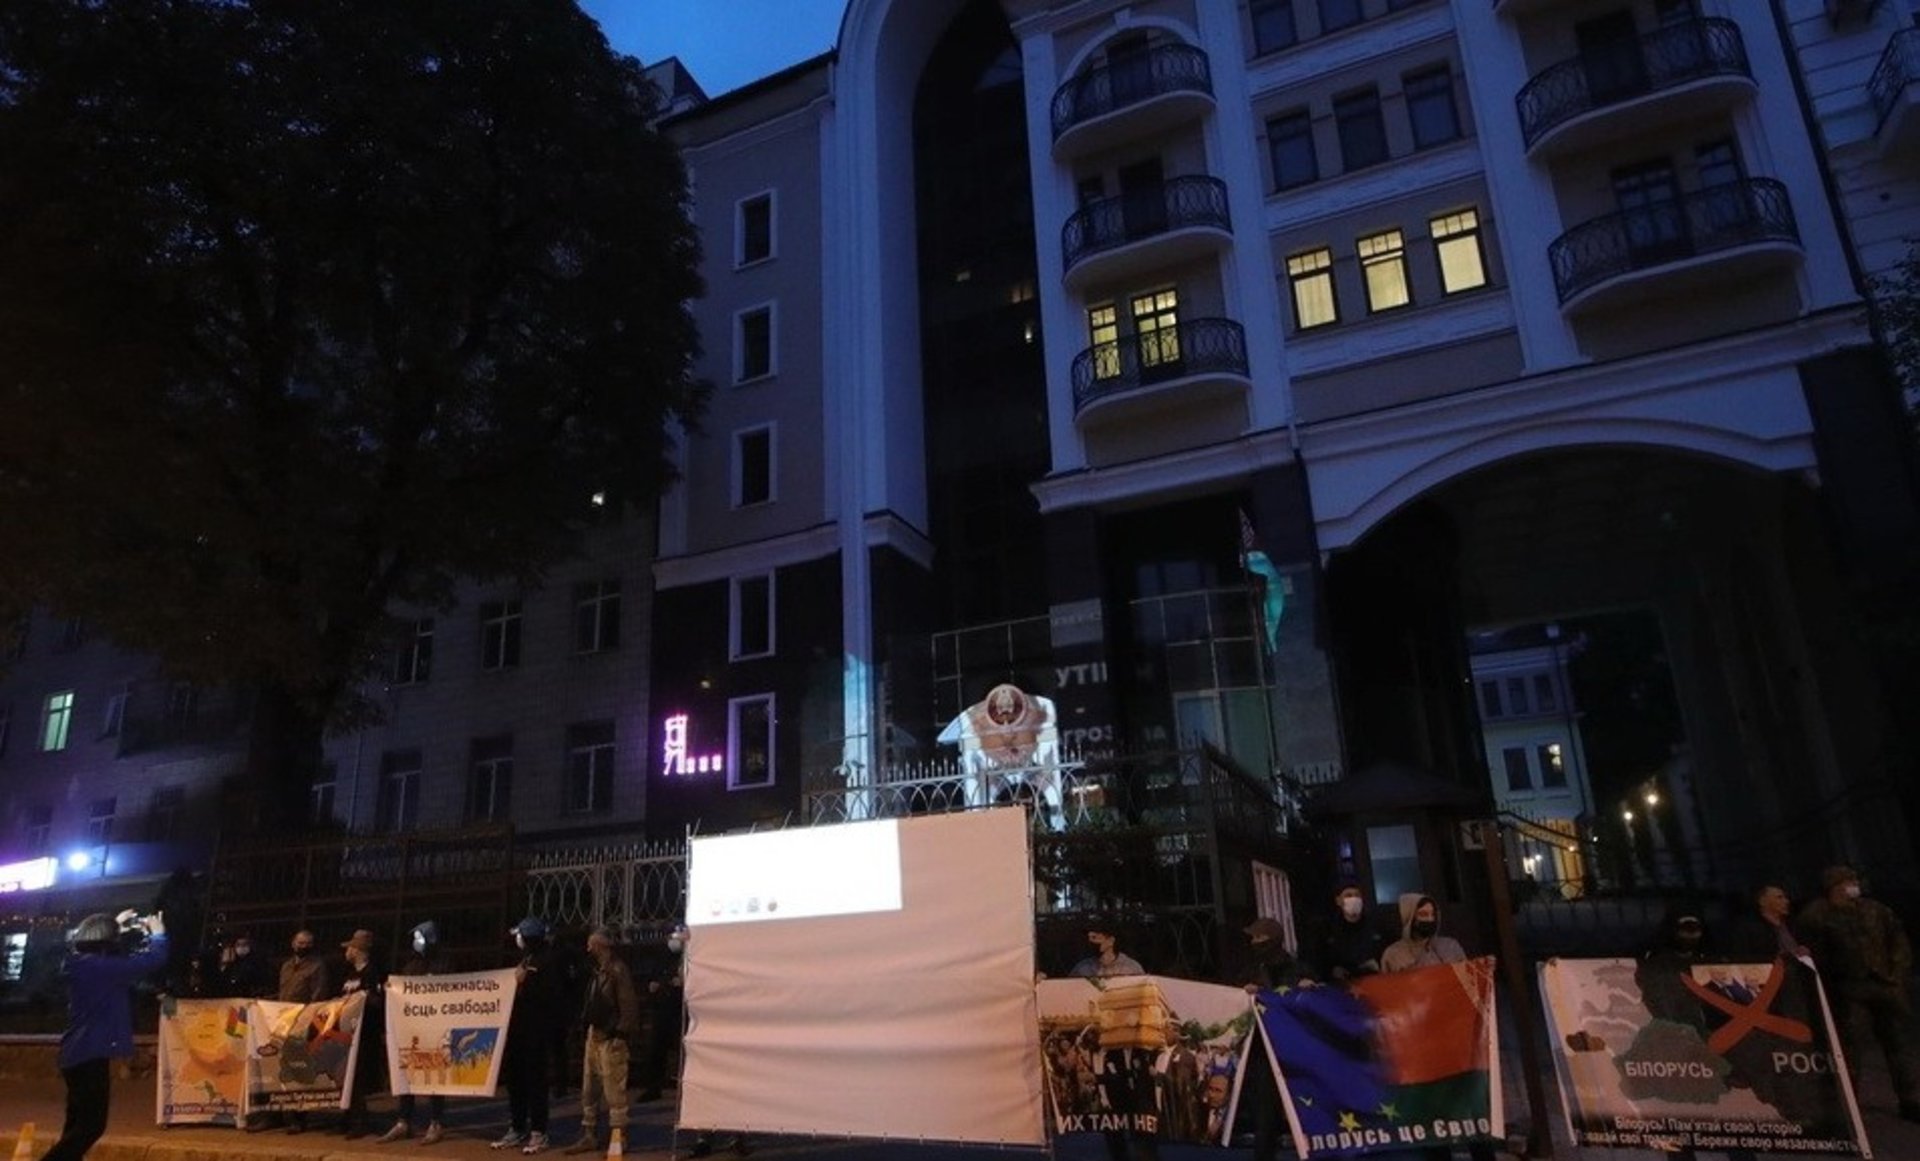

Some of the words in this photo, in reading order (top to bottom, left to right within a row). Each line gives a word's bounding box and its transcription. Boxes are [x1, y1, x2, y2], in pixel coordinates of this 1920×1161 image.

[403, 979, 500, 995] Незалежнасць
[404, 1002, 438, 1017] ёсць
[441, 999, 500, 1016] свабода!
[1625, 1060, 1714, 1079] БІЛОРУСЬ
[1088, 1112, 1129, 1132] ТАМ
[1723, 1121, 1756, 1134] свою
[1757, 1122, 1803, 1137] історію
[1398, 1123, 1426, 1144] це
[1694, 1134, 1738, 1149] Бережи
[1740, 1137, 1772, 1151] свою
